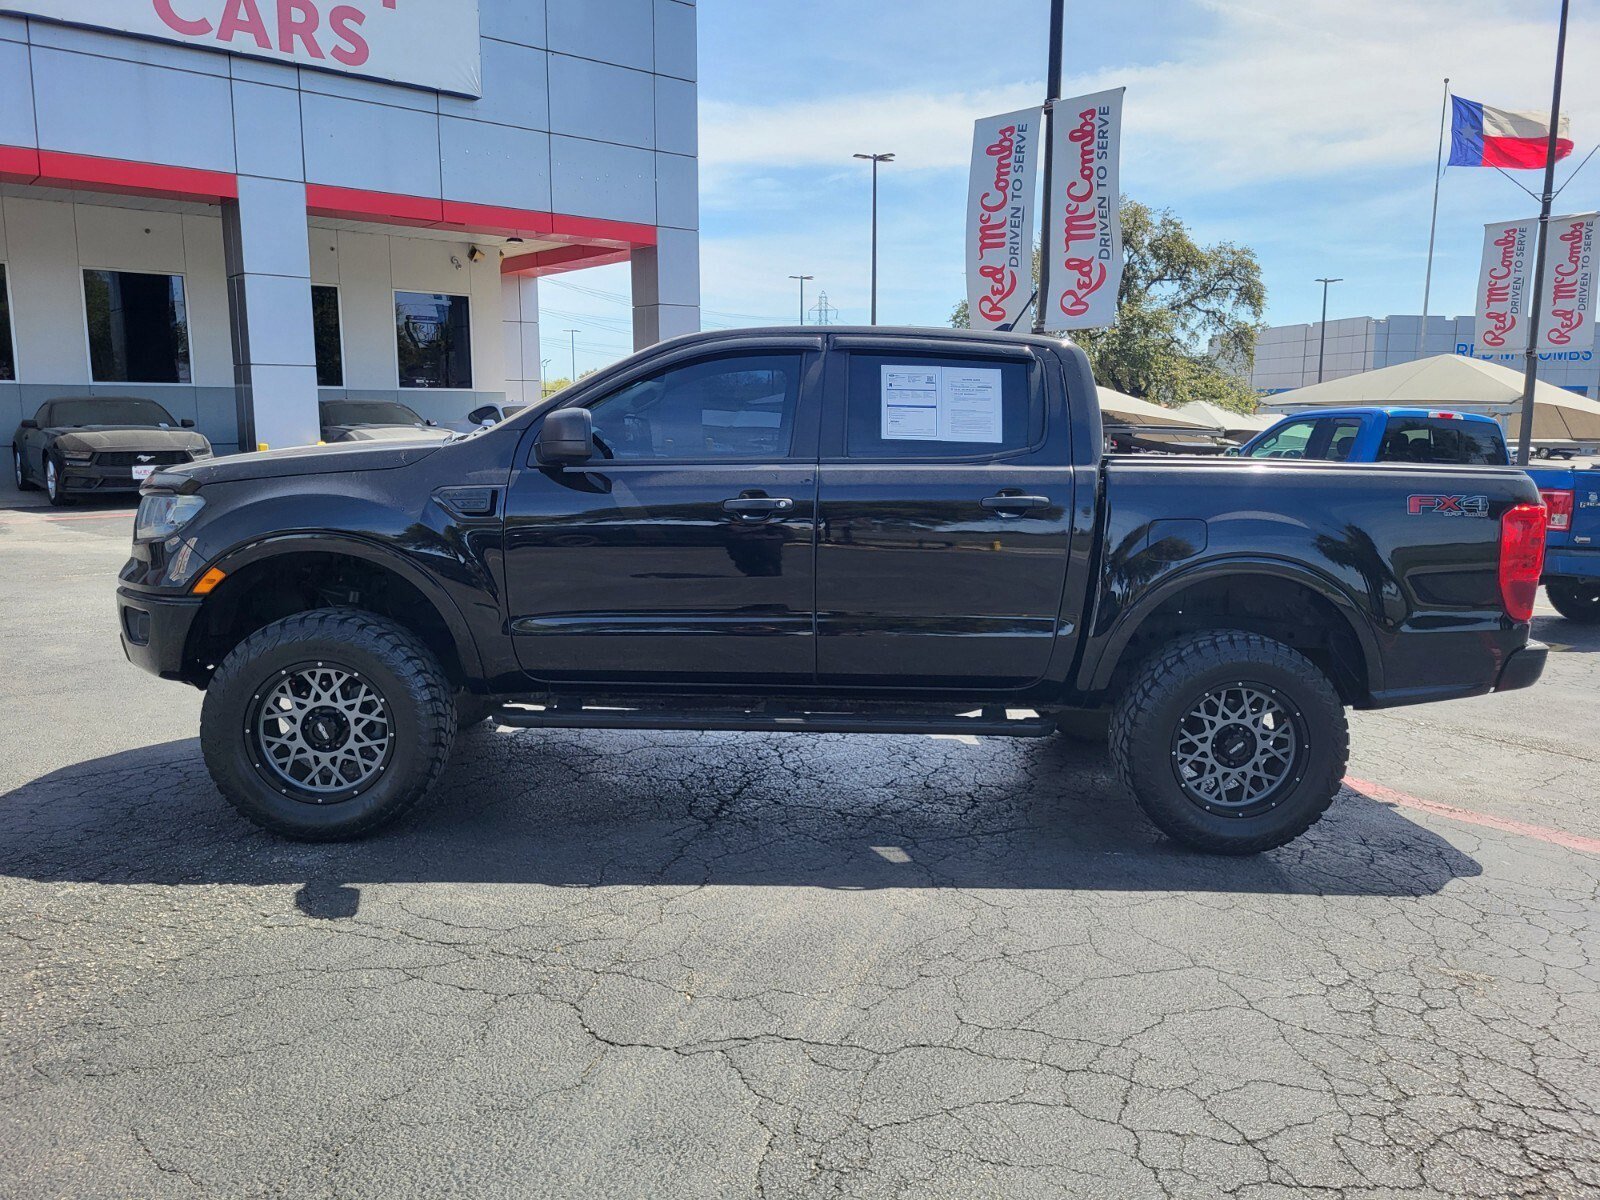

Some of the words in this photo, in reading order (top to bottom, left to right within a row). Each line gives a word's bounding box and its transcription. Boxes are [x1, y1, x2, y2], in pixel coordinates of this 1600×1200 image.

[153, 0, 369, 66] CARS
[1014, 123, 1028, 173] SERVE
[1097, 105, 1110, 160] SERVE
[978, 125, 1016, 261] McCombs
[1011, 178, 1023, 202] TO
[1064, 107, 1097, 253] McCombs
[1097, 165, 1108, 192] TO
[1008, 206, 1022, 268] DRIVEN
[1097, 196, 1110, 261] DRIVEN
[1516, 227, 1527, 257] SERVE
[1583, 220, 1594, 252] SERVE
[1485, 228, 1518, 309] McCombs
[1513, 260, 1523, 273] TO
[1552, 221, 1584, 307] McCombs
[1581, 255, 1590, 269] TO
[978, 263, 1017, 322] Red
[1060, 256, 1107, 317] Red
[1510, 277, 1522, 314] DRIVEN
[1578, 273, 1589, 311] DRIVEN
[1483, 311, 1516, 347] Red
[1547, 309, 1583, 345] Red
[1407, 494, 1489, 515] FX4
